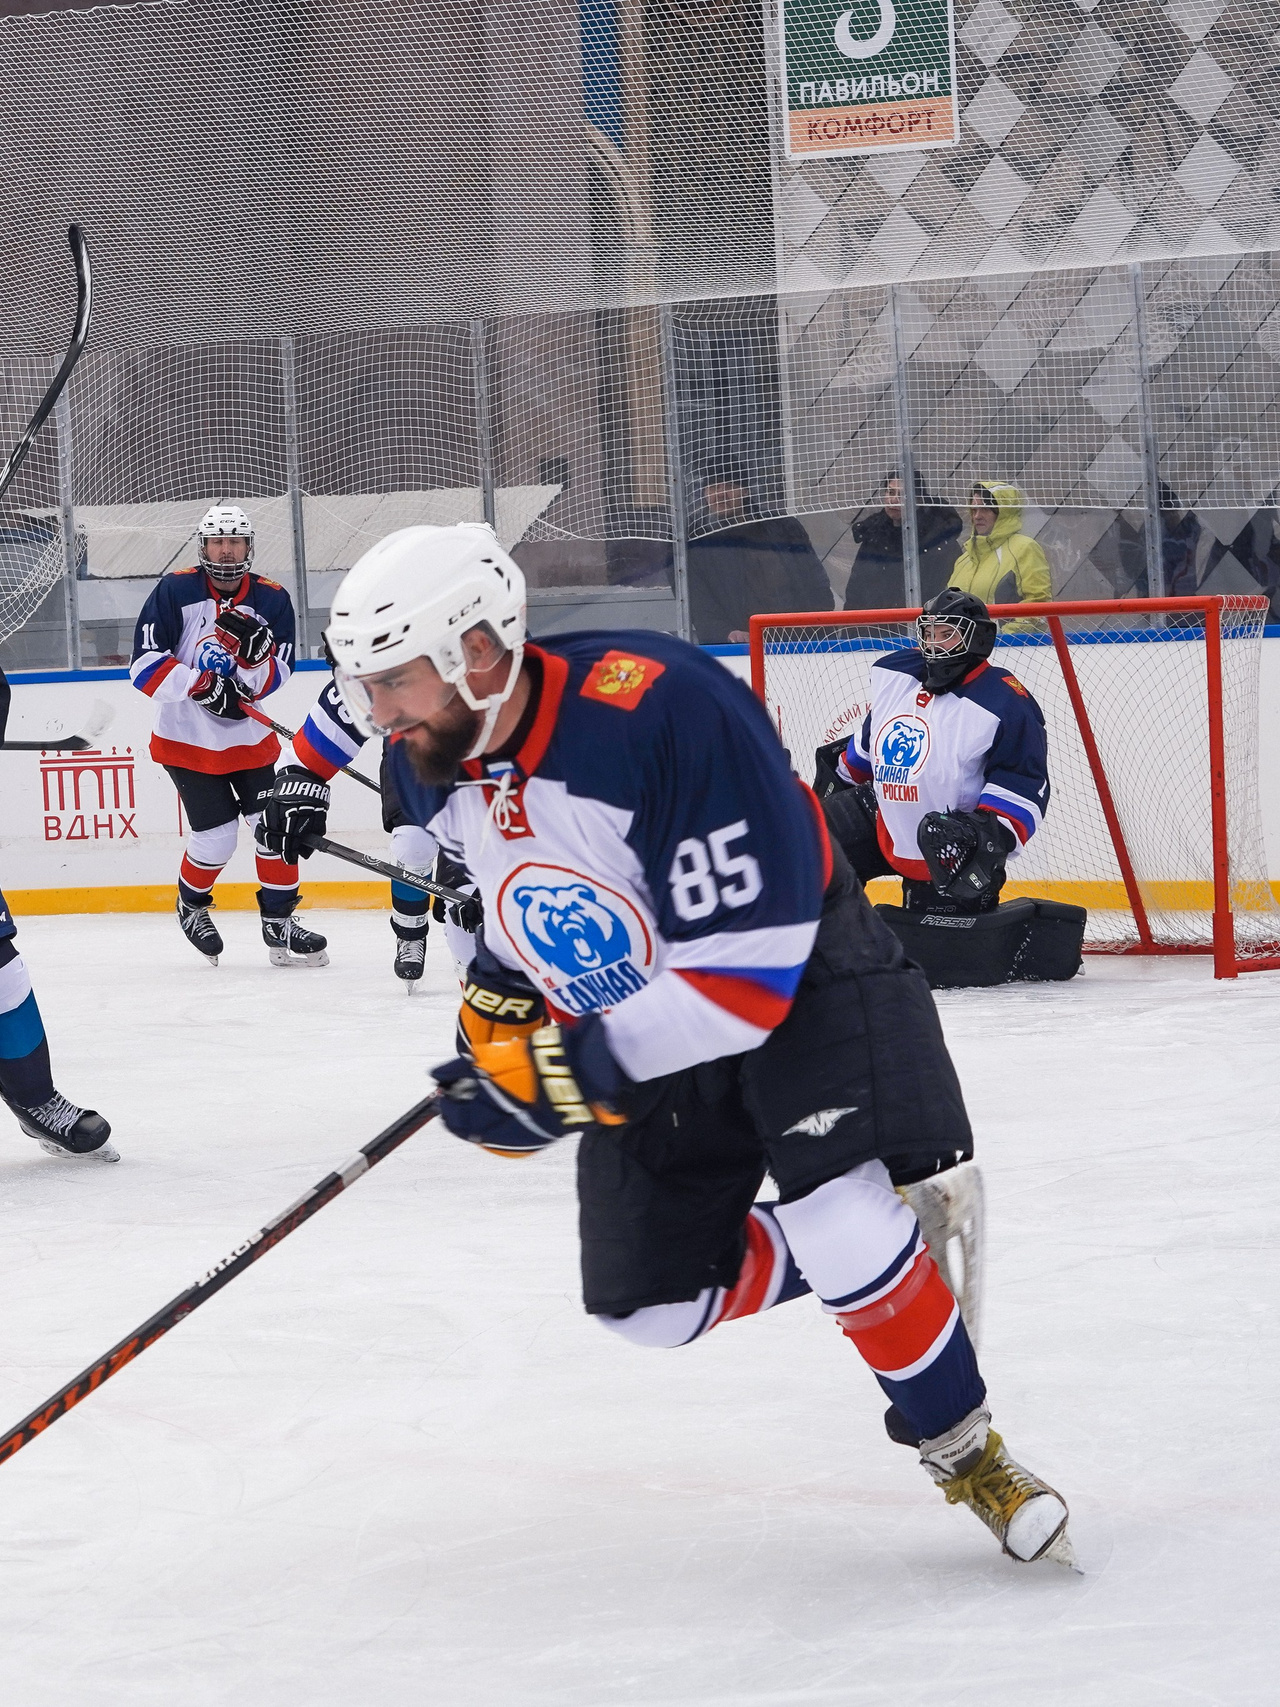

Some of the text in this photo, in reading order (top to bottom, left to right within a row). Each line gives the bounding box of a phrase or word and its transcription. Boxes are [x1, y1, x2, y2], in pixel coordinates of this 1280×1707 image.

[799, 70, 940, 104] ПАВИЛЬОН
[807, 109, 936, 141] КОМФОРТ
[448, 596, 482, 626] CCM
[141, 623, 159, 650] 11
[874, 764, 910, 785] ЕДИНАЯ
[278, 781, 330, 801] WARR
[882, 783, 919, 802] РОССИЯ
[44, 813, 139, 841] ВДНХ
[668, 818, 764, 922] 85
[920, 914, 977, 929] PASSAU
[941, 1433, 978, 1460] BAUER
